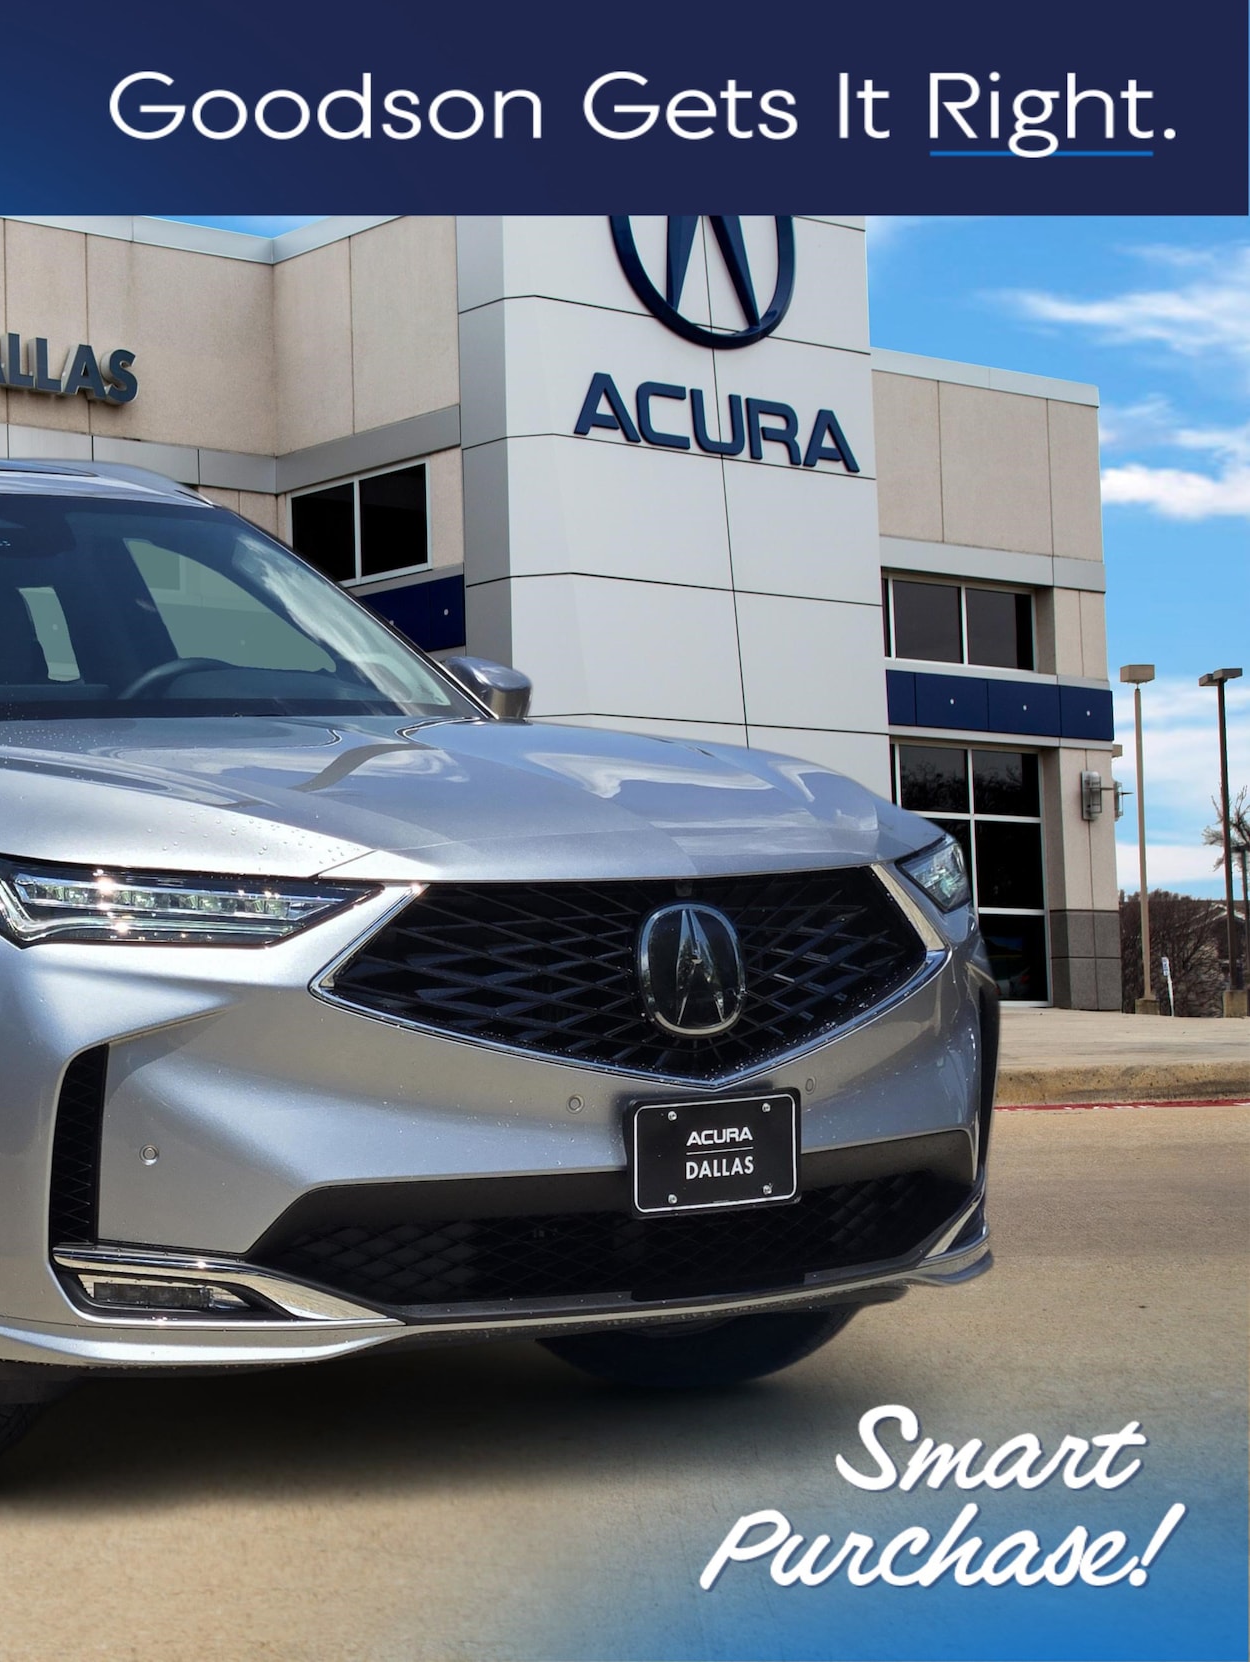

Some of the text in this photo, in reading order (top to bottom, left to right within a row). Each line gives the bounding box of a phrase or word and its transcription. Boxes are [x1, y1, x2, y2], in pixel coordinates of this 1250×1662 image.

[573, 372, 860, 473] ACURA
[686, 1126, 754, 1147] ACURA
[686, 1156, 755, 1180] DALLAS
